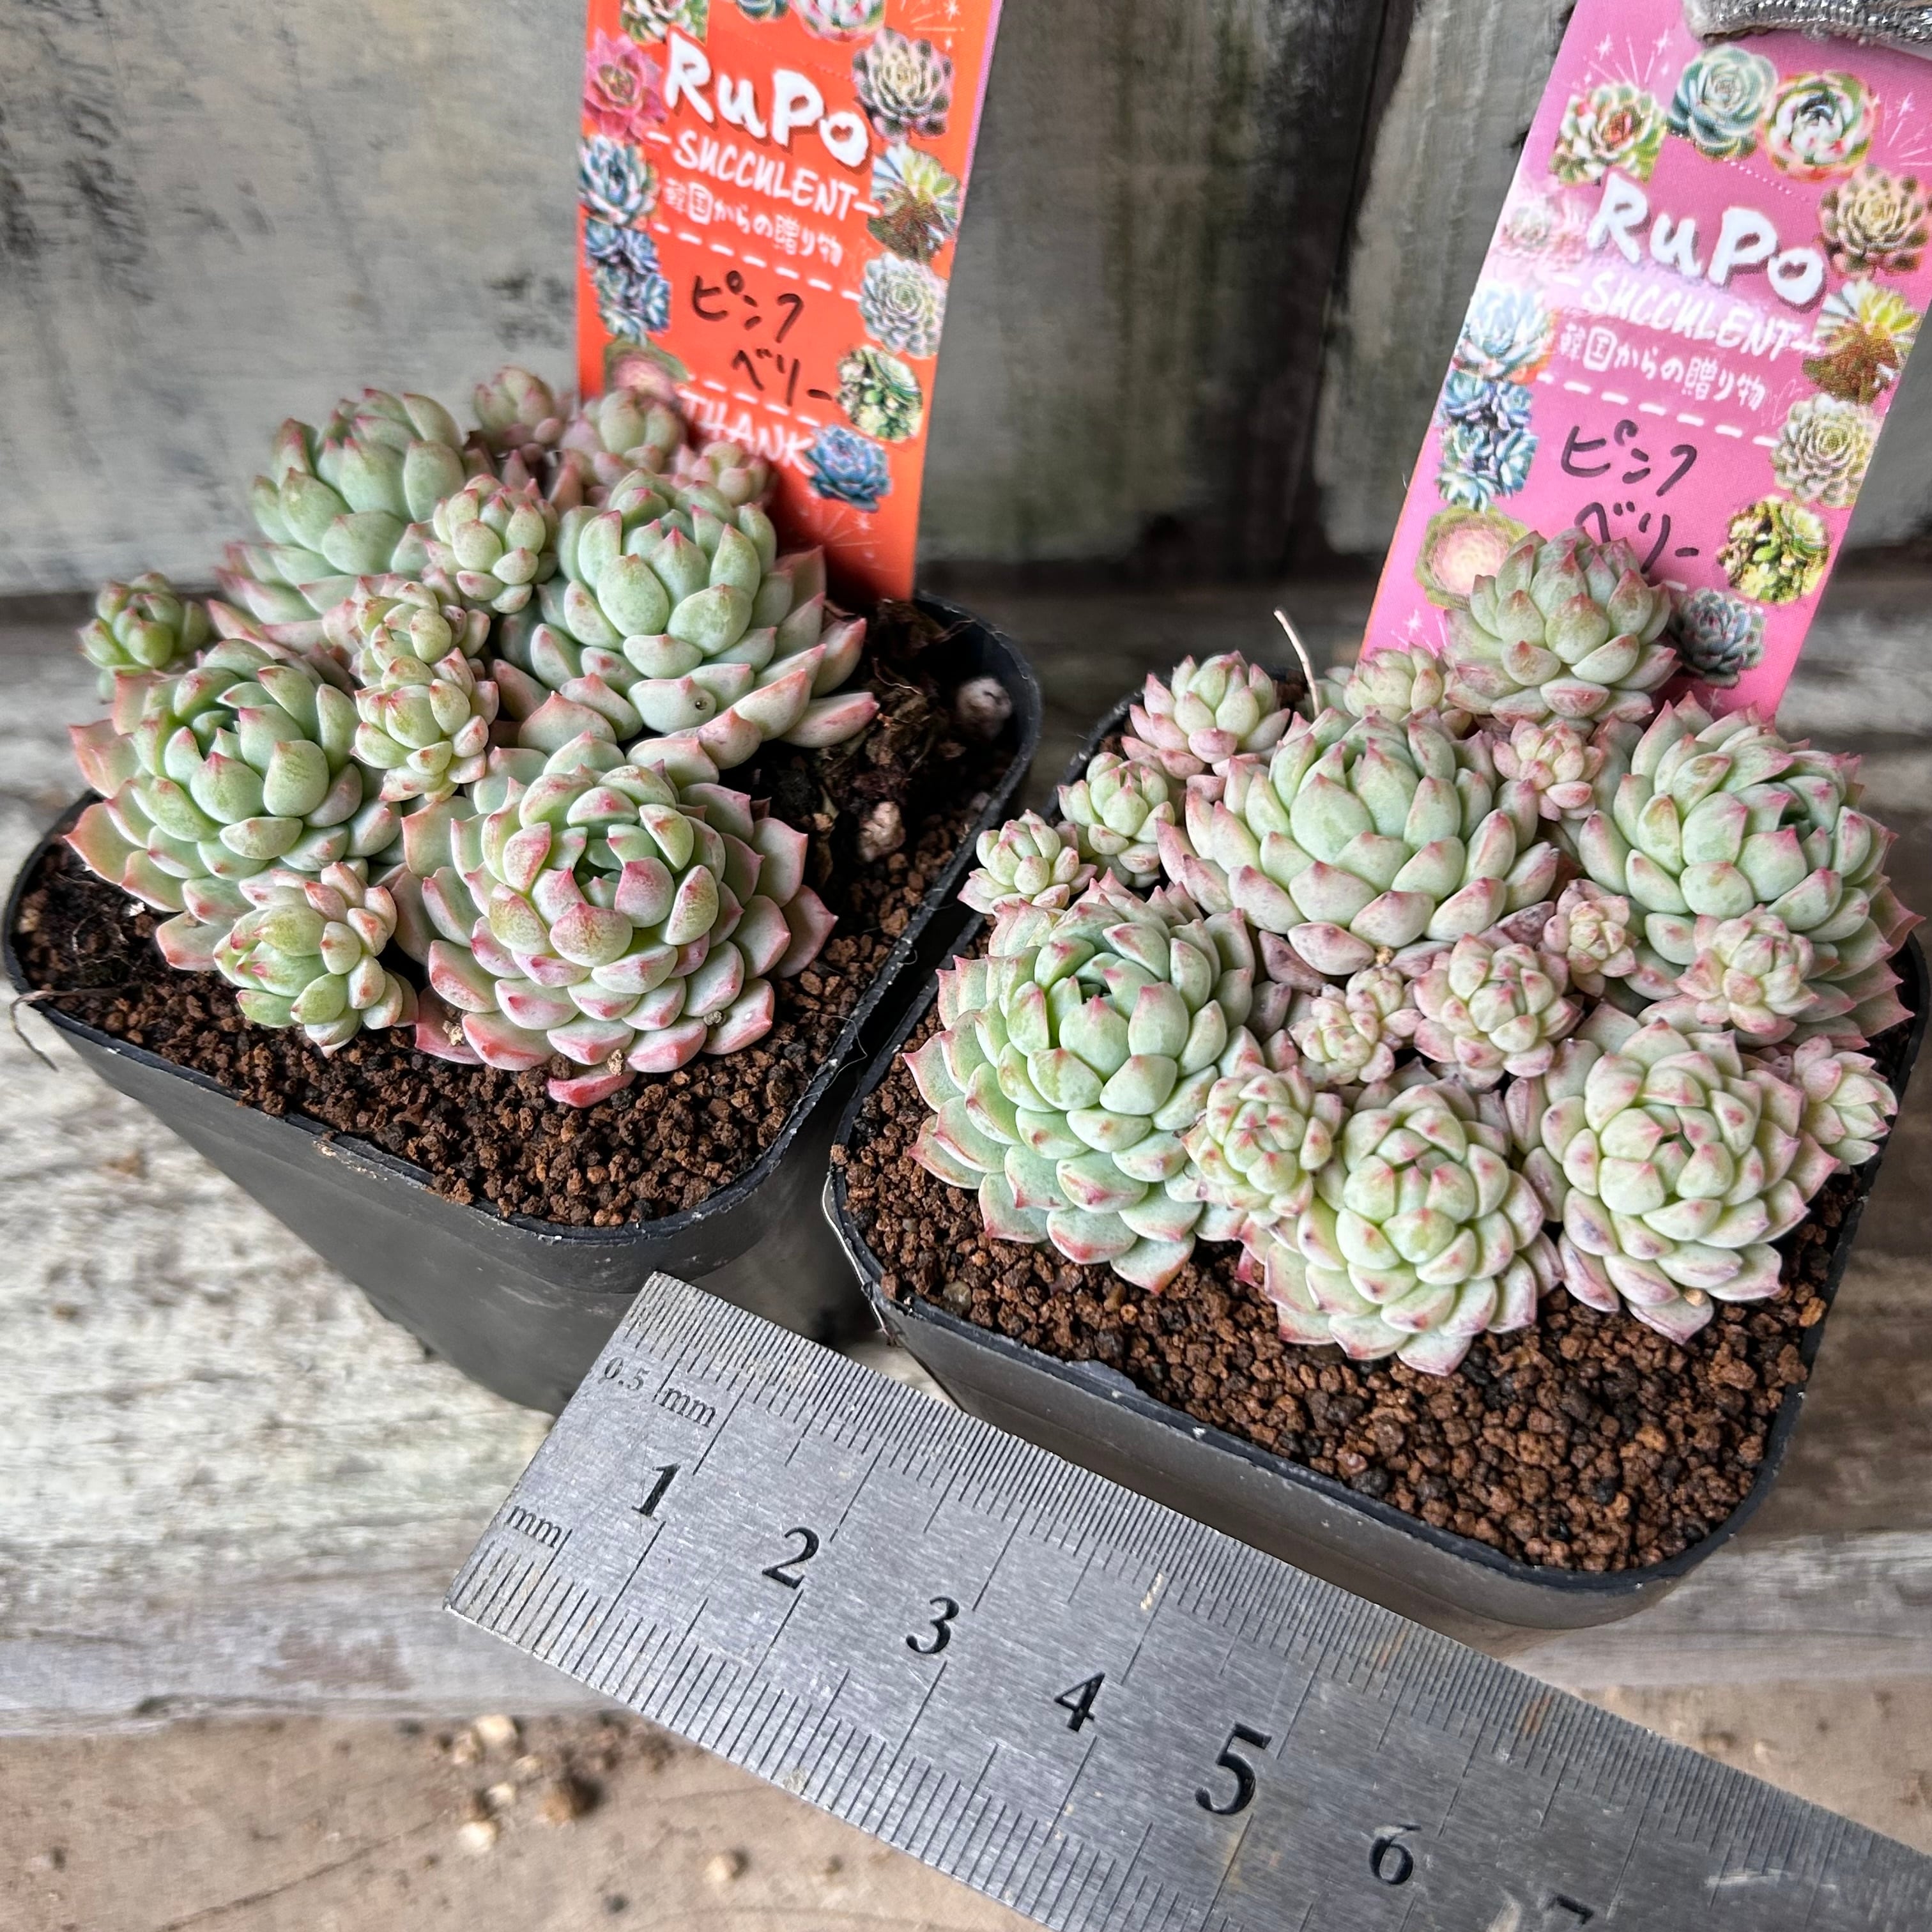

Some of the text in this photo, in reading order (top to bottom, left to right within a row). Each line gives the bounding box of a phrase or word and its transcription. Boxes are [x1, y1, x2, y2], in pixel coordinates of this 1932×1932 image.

[664, 27, 870, 167] RuPo
[1586, 172, 1826, 305] RuPo
[1560, 322, 1766, 411] 韓国からの贈り物
[678, 389, 816, 476] THANK
[603, 1356, 717, 1429] 0.5 mm
[504, 1503, 563, 1550] mm
[631, 1462, 680, 1519] 1
[761, 1526, 820, 1590] 2
[905, 1597, 960, 1655] 3
[1054, 1671, 1106, 1733] 4
[1194, 1722, 1273, 1815] 5
[1367, 1823, 1423, 1886] 6
